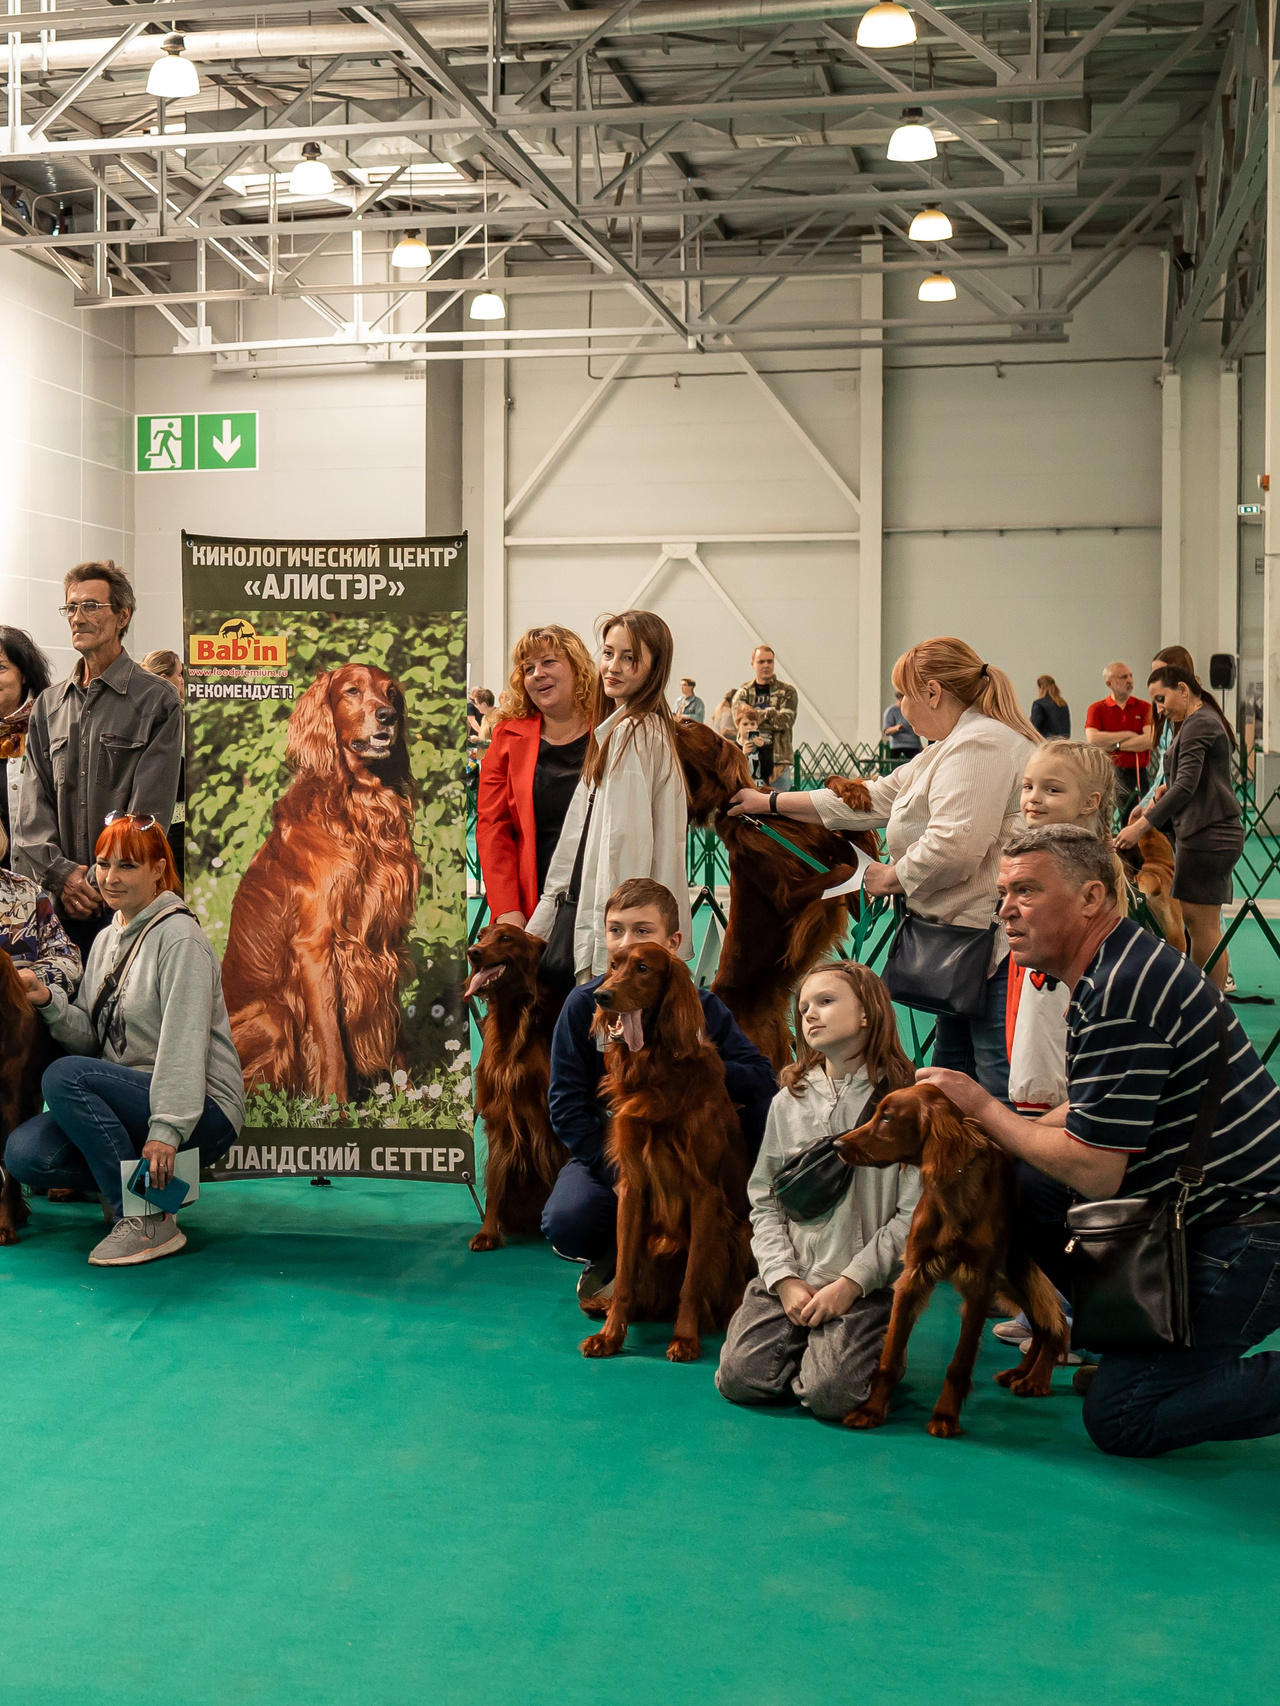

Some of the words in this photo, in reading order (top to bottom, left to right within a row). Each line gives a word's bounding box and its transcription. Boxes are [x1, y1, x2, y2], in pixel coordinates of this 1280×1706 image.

[192, 545, 380, 568] КИНОЛОГИЧЕСКИЙ
[388, 547, 458, 571] ЦЕНТР
[243, 573, 406, 601] «АЛИСТЭР»
[197, 638, 278, 662] Bab'in
[188, 667, 289, 678] www.foodpremium.ru
[187, 683, 294, 701] РЕКОМЕНДУЕТ!
[205, 1142, 360, 1174] ЛАНДСКИЙ
[370, 1146, 466, 1172] СЕТТЕР
